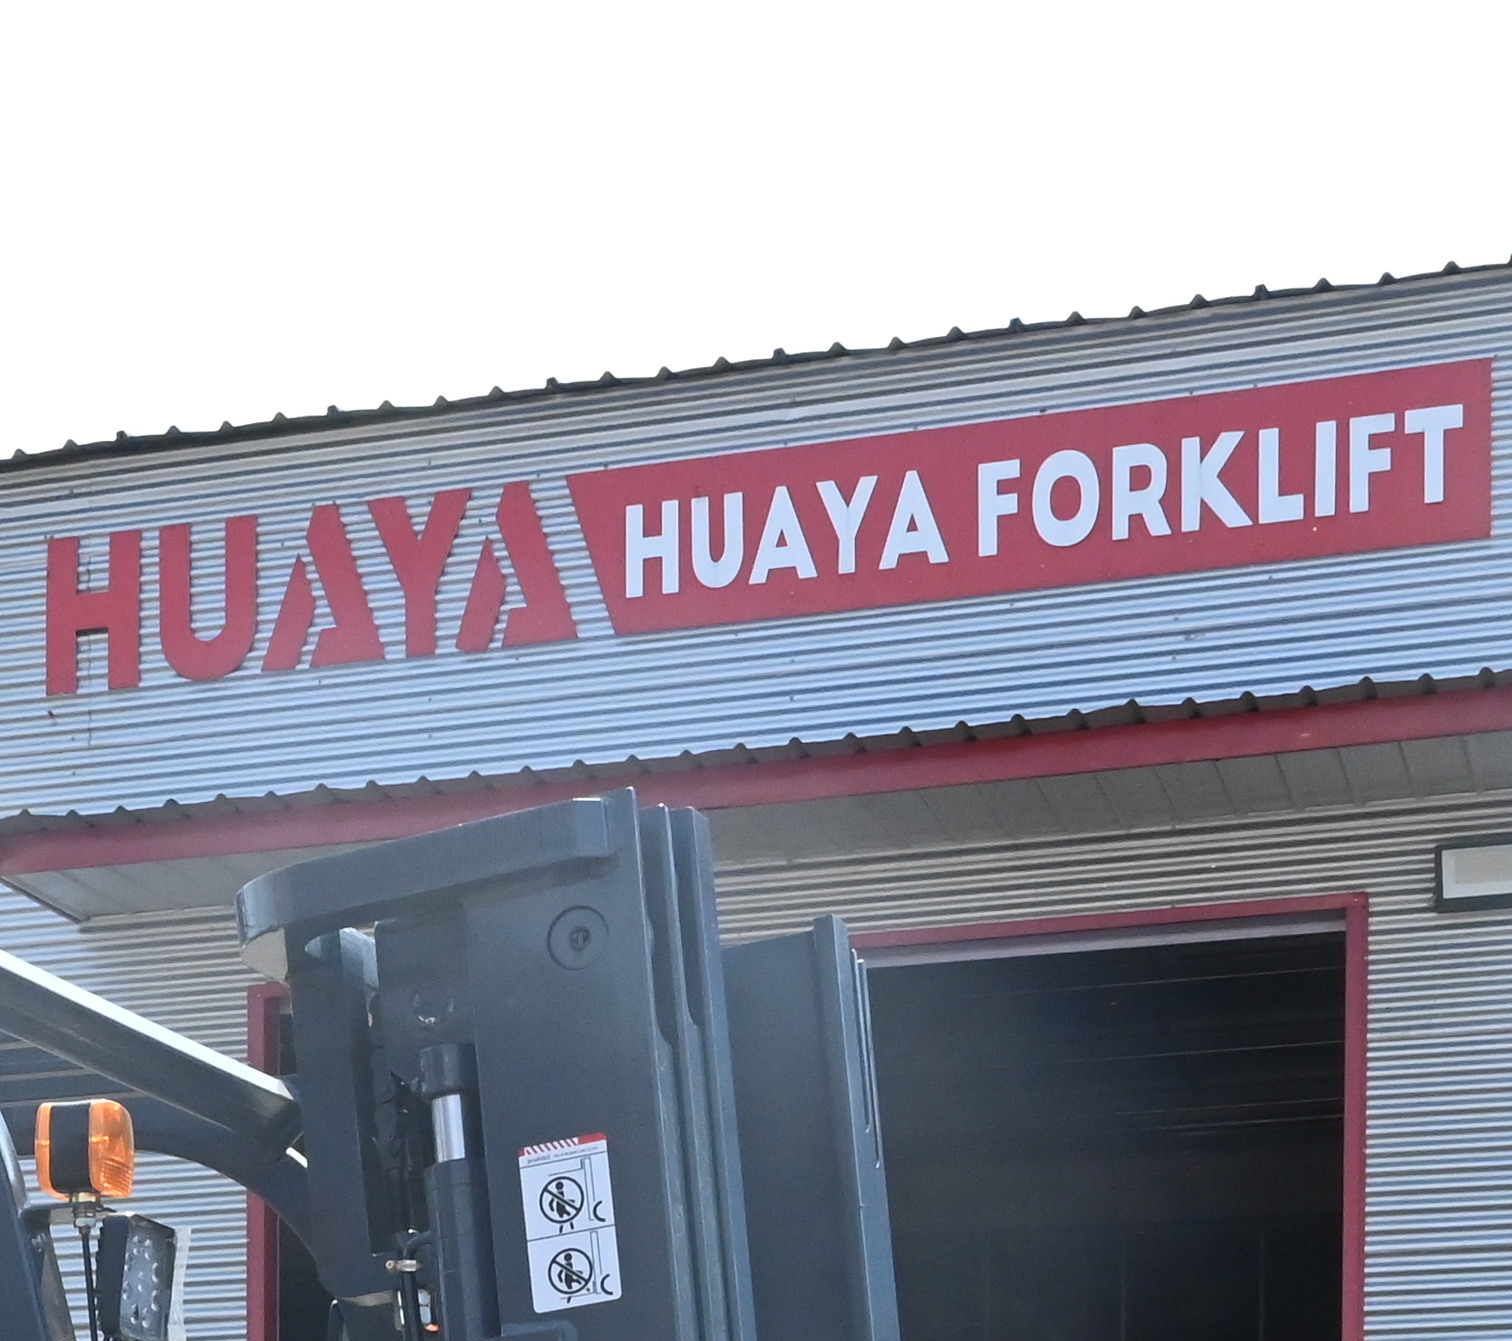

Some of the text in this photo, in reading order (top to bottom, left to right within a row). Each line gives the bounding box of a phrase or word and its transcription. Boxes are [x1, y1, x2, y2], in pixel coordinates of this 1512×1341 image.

[46, 481, 578, 697] HUAYA
[624, 403, 1464, 598] HUAYA FORKLIFT
